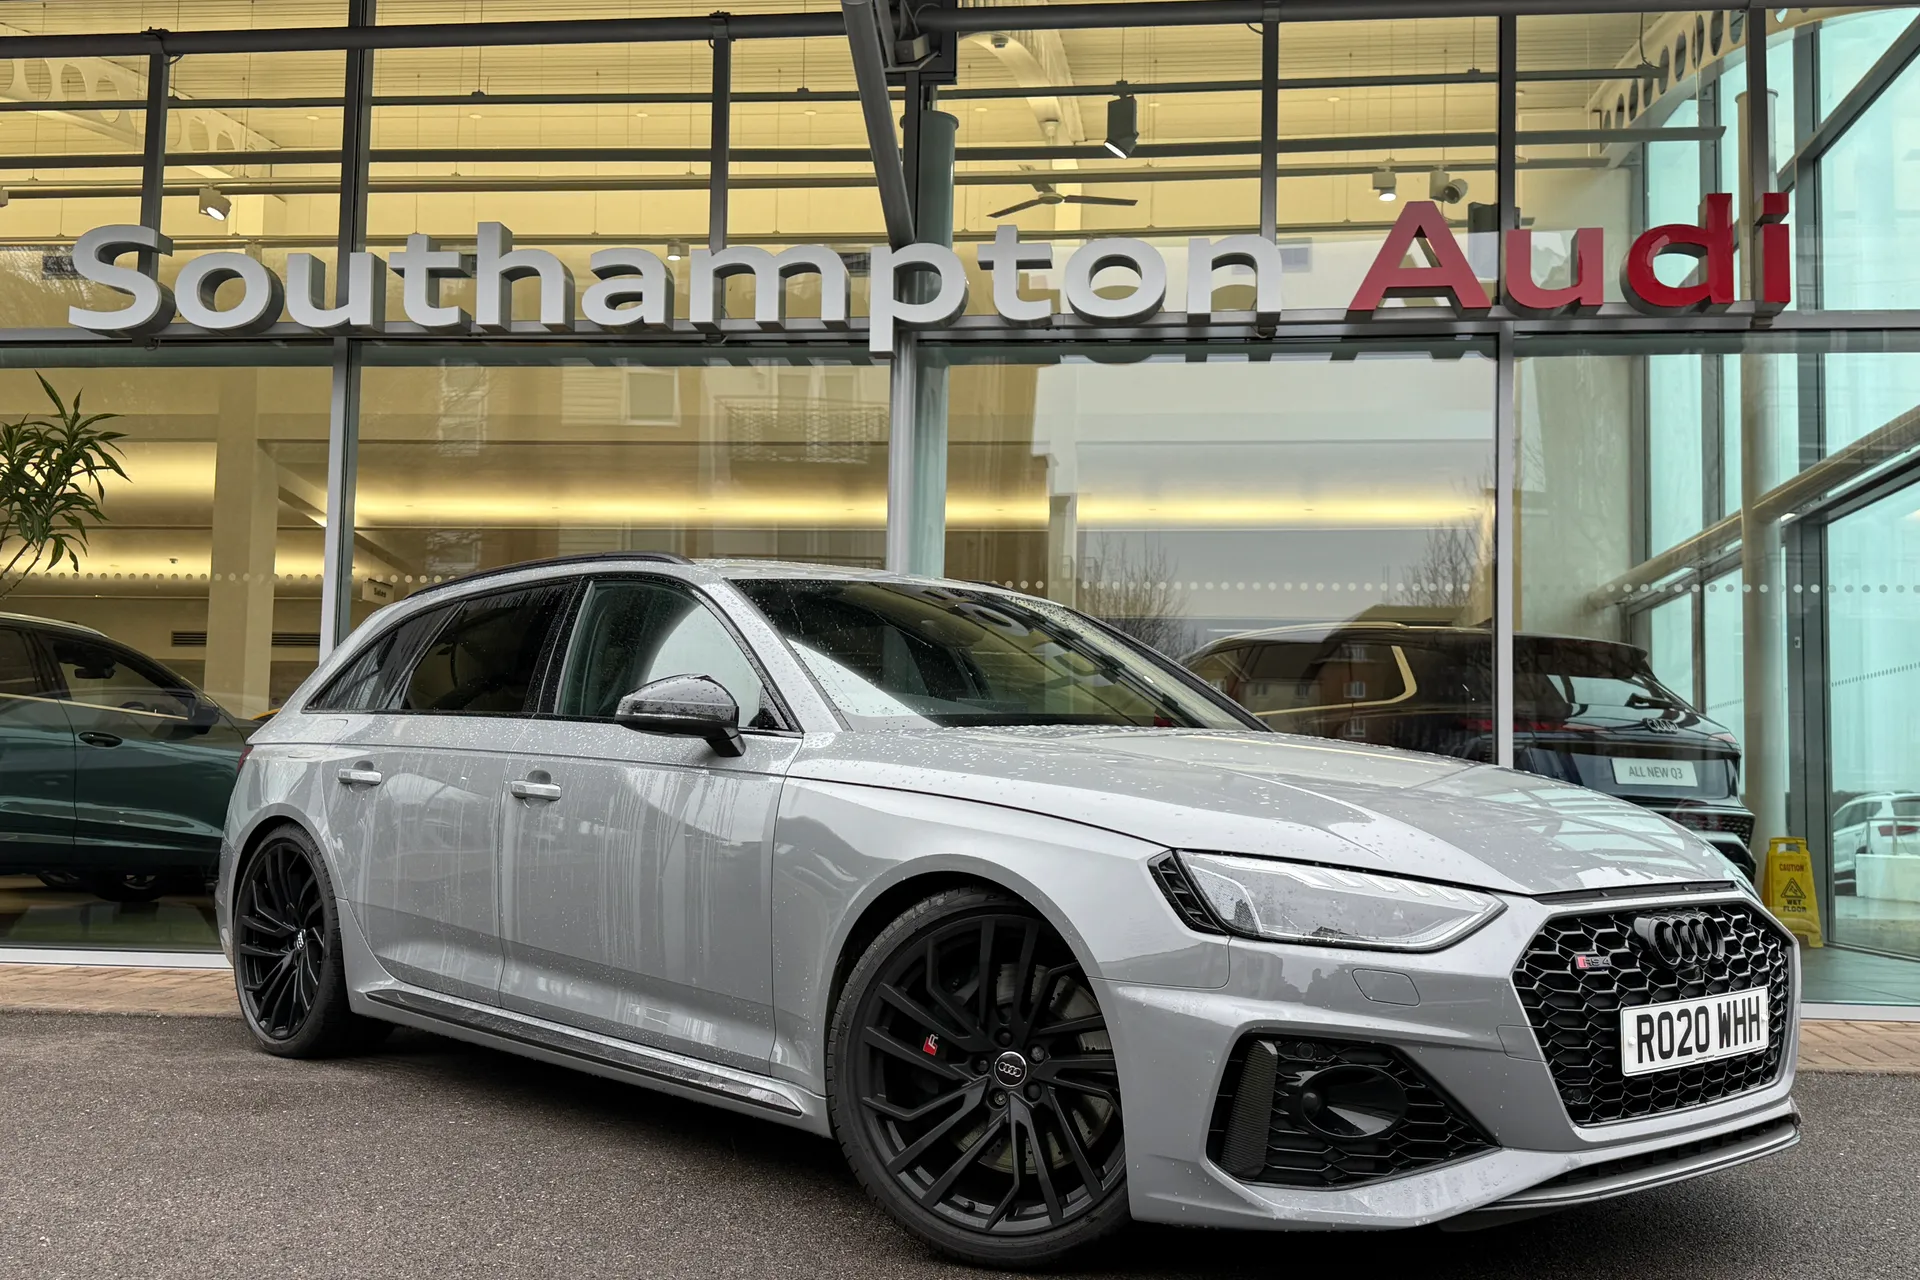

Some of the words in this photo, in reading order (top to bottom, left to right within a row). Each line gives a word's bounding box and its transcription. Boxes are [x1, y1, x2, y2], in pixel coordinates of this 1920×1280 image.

[69, 222, 1283, 356] Southampton
[1347, 193, 1791, 317] Audi
[1628, 765, 1646, 778] ALL
[1647, 766, 1669, 779] NEW
[1670, 768, 1683, 780] Q3
[1779, 863, 1804, 872] CAUTION
[1636, 1005, 1710, 1064] RO20
[1717, 995, 1761, 1049] WHH
